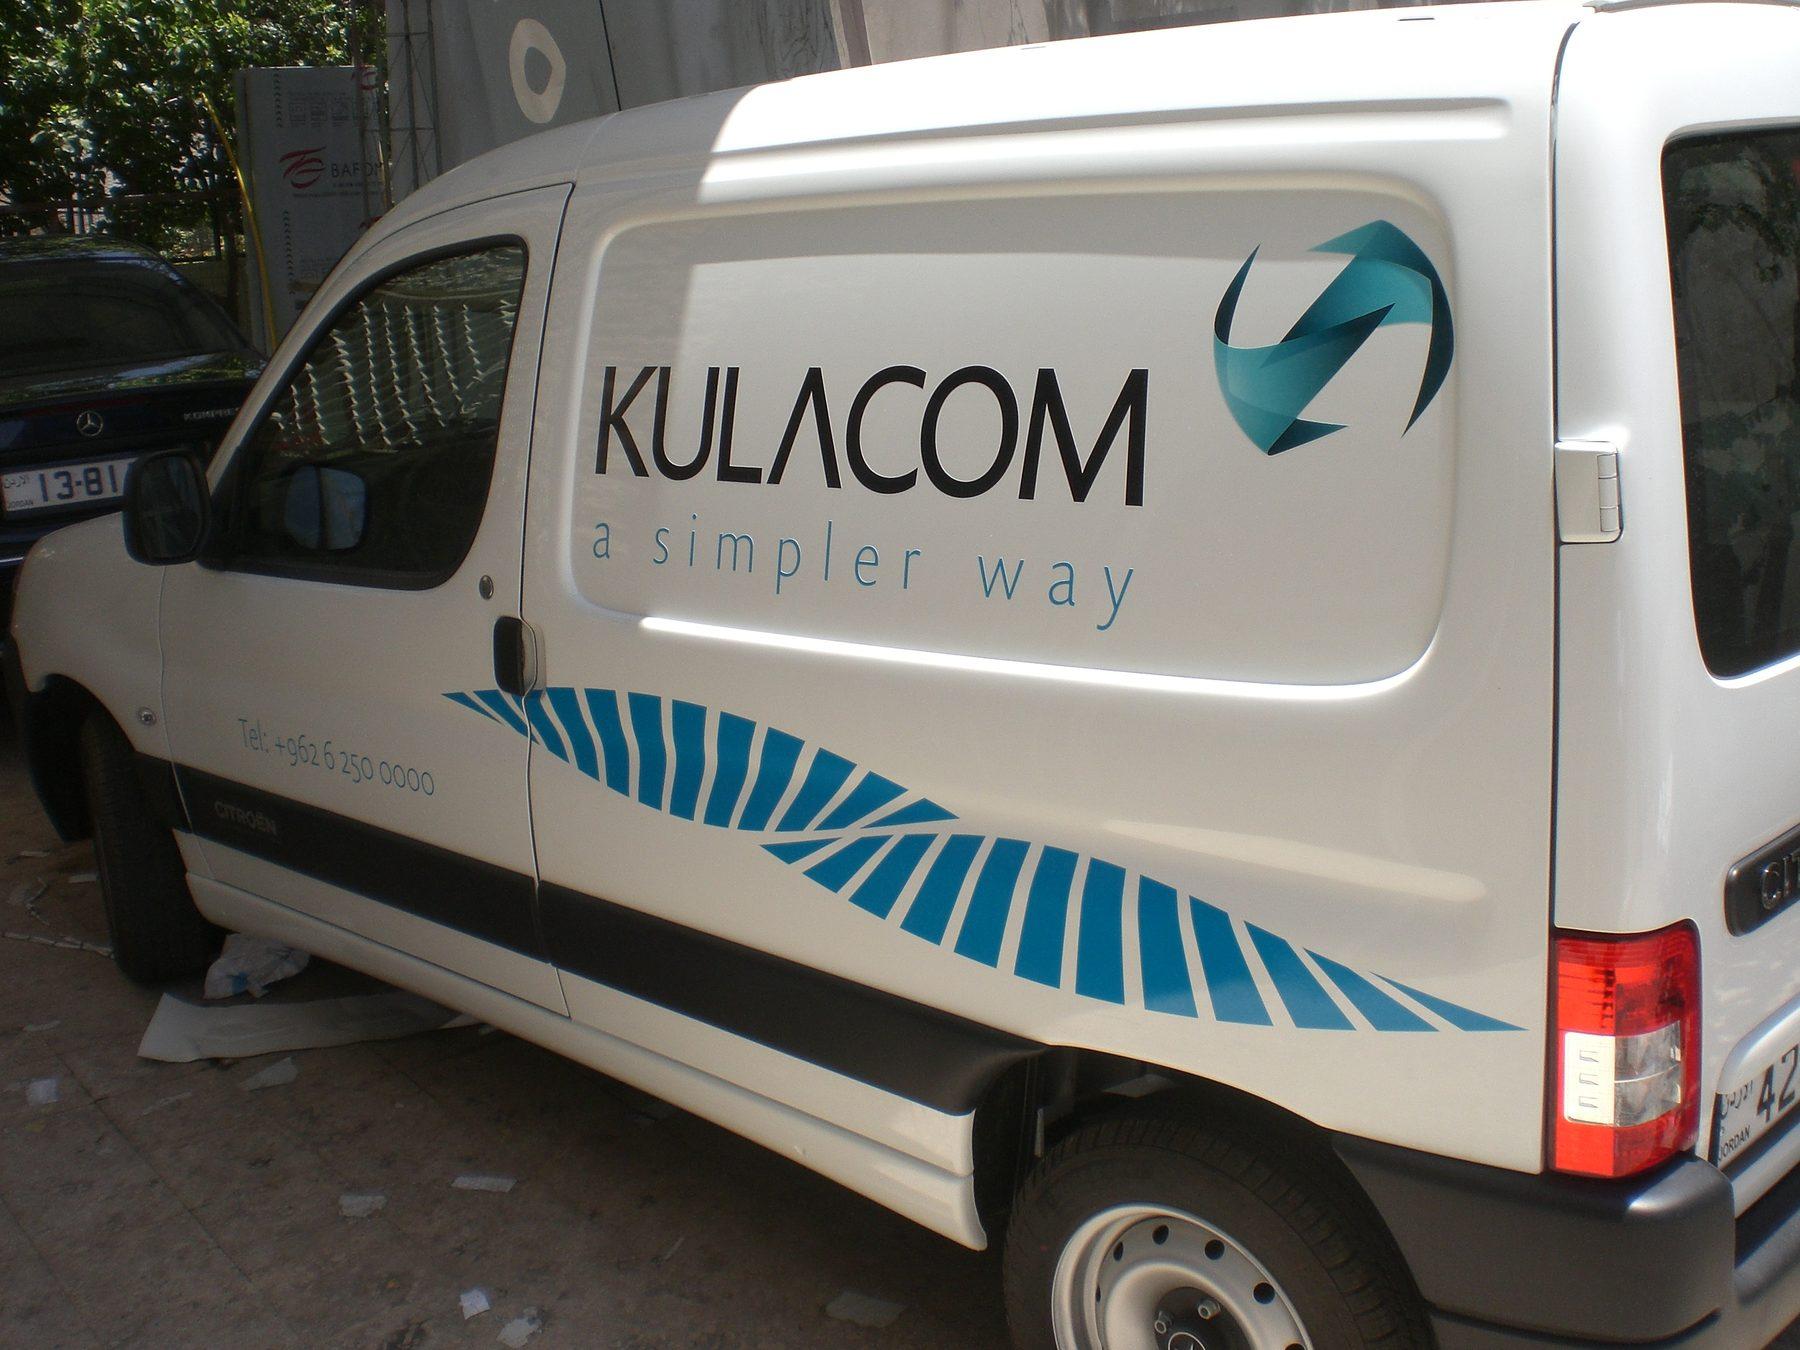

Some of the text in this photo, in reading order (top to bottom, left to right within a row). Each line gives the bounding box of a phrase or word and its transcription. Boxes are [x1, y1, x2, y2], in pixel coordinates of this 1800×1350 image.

[595, 365, 1149, 507] KULACOM
[592, 513, 1135, 631] a simpler way
[238, 717, 269, 753] Tel:
[323, 740, 335, 771] 6
[338, 750, 374, 784] 250
[379, 761, 435, 797] 0000
[1755, 1042, 1800, 1123] 42
[1718, 1124, 1751, 1162] JORDAN
